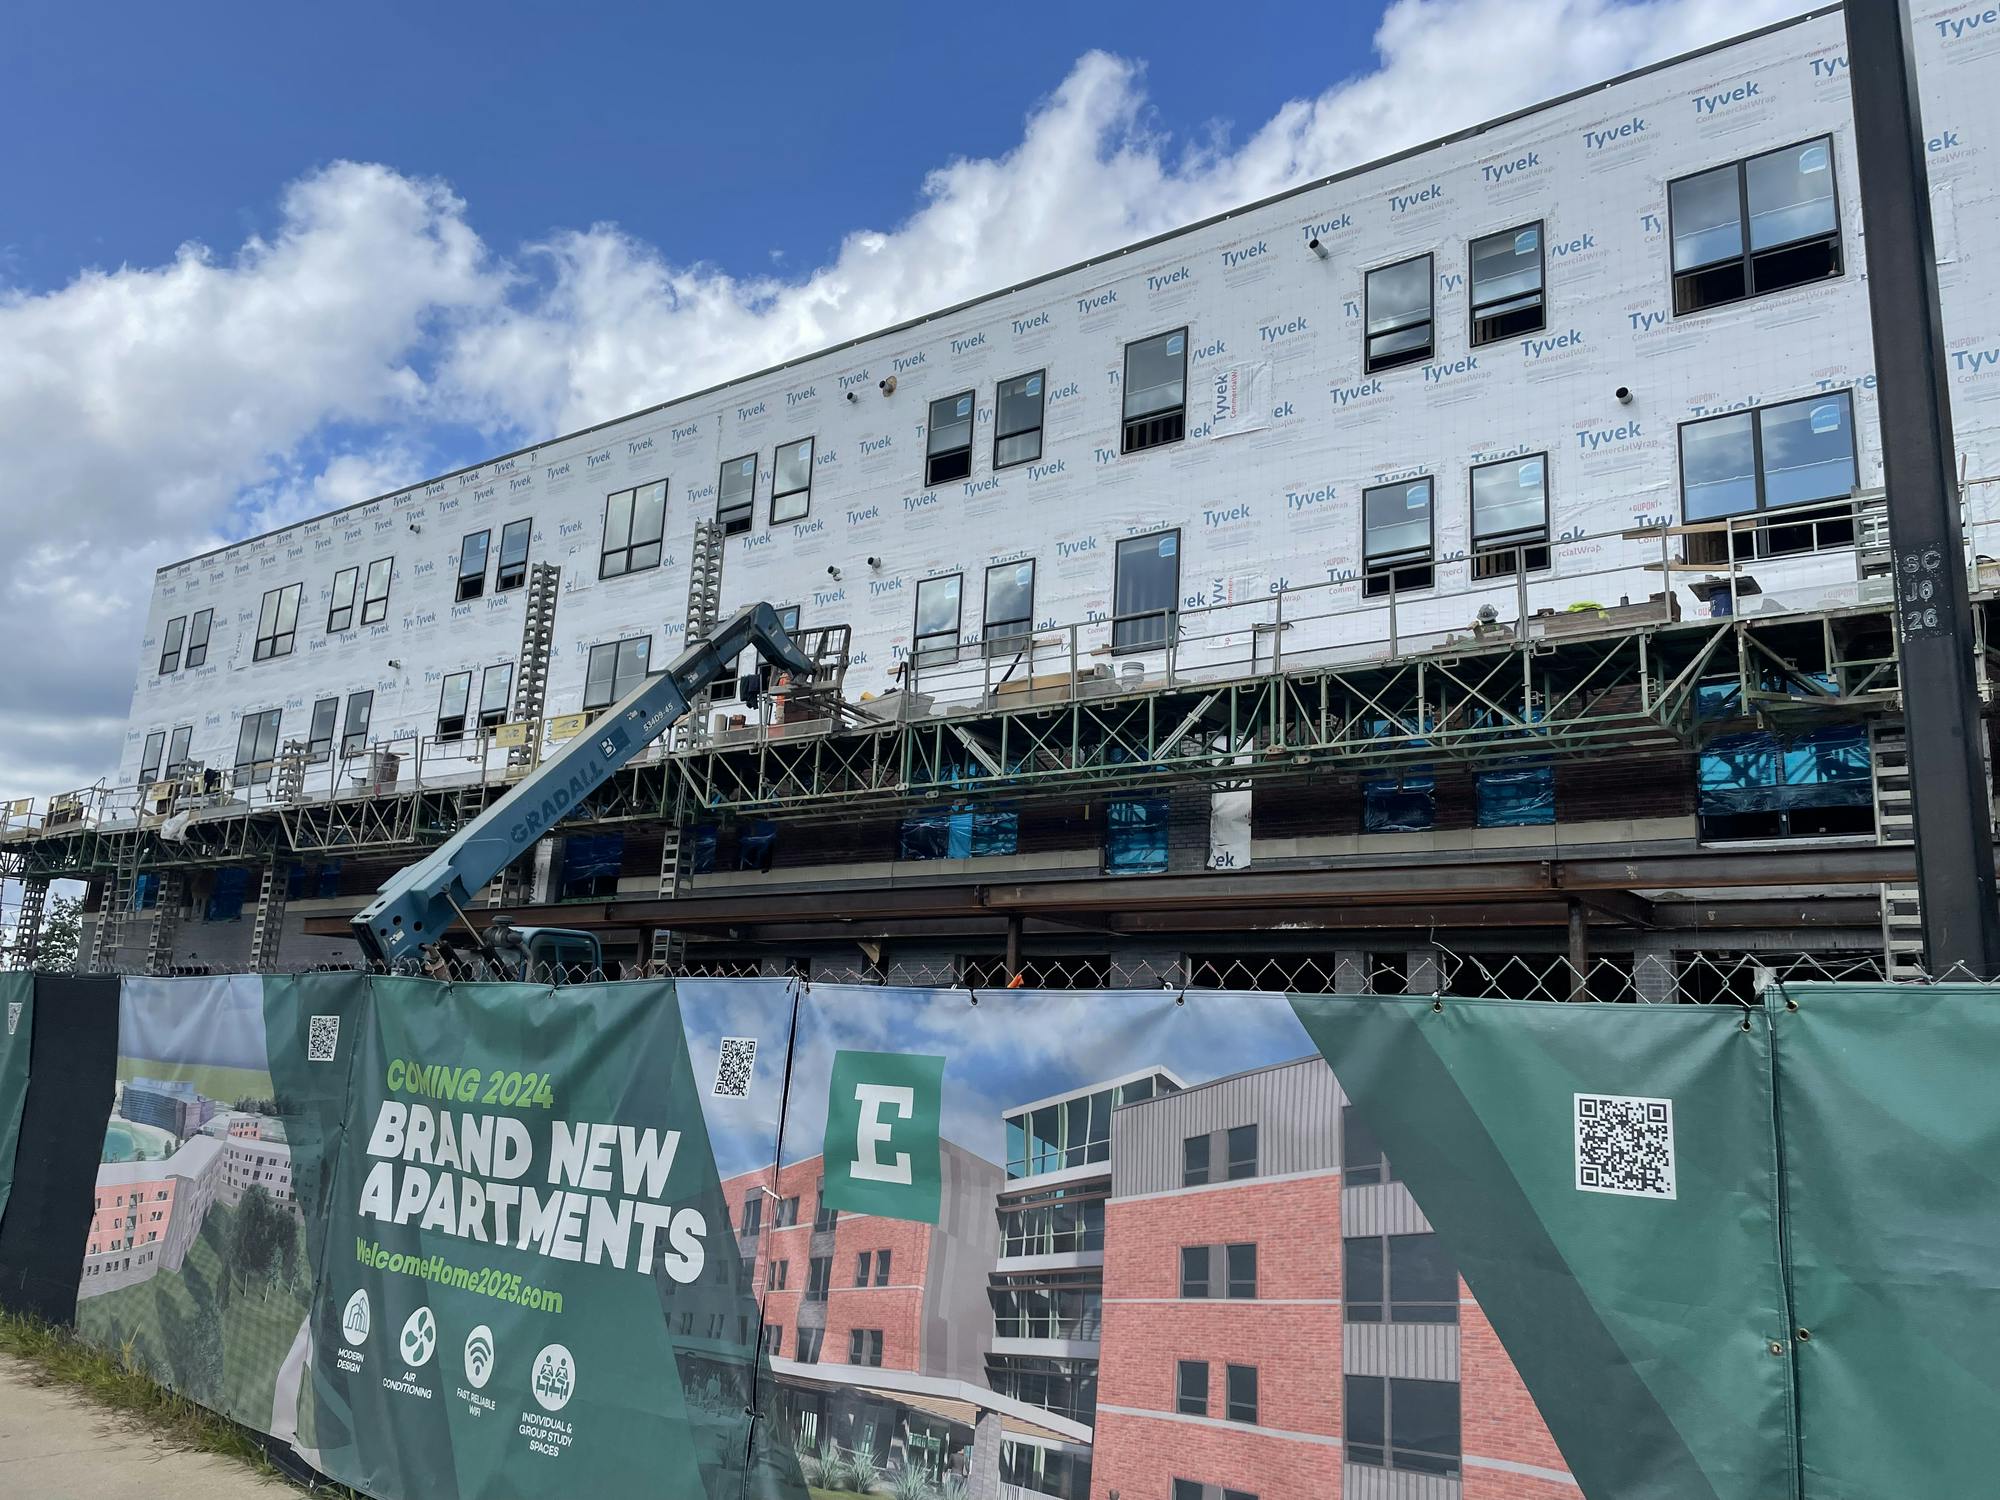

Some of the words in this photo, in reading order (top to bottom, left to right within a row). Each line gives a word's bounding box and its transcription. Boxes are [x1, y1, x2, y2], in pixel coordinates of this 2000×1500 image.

[1935, 9, 2000, 38] Tyve
[1810, 56, 1850, 77] Tyv
[1692, 81, 1760, 114] Tyvek
[1695, 95, 1777, 124] CommercialWrap
[1583, 117, 1645, 148] Tyvek
[1586, 132, 1661, 159] CommercialWrap
[1926, 145, 1977, 167] rcialWrap
[1482, 152, 1538, 182] Tyvek
[1484, 166, 1553, 192] CommercialWrap
[1388, 184, 1441, 212] Tyvek
[1302, 214, 1351, 239] Tyvek
[1221, 241, 1267, 266] Tyvek
[1550, 234, 1594, 257] vek
[1549, 249, 1611, 272] ommercialWrap
[1147, 266, 1190, 291] Tyvek
[1077, 290, 1117, 313] Tyvek
[1011, 312, 1049, 335] Tyvek
[1628, 309, 1665, 331] Tyv
[1259, 316, 1307, 342] Tyvek
[951, 333, 985, 354] Tyvek
[1520, 329, 1582, 358] Tyvek
[893, 352, 925, 372] Tyvek
[1523, 345, 1597, 367] CommercialWrap
[1952, 349, 2000, 372] Tyv
[1422, 356, 1478, 383] Tyvek
[838, 369, 869, 389] Tyvek
[1423, 370, 1492, 392] CommercialWrap
[786, 387, 816, 405] Tyvek
[1049, 383, 1078, 404] yvek
[1213, 373, 1230, 425] Tyvek
[1330, 379, 1382, 406] Tyvek
[738, 403, 765, 420] Tyvek
[1332, 394, 1394, 414] CommercialWrap
[672, 424, 697, 440] Tyvek
[1577, 421, 1641, 450] Tyvek
[628, 438, 653, 454] Tyvek
[860, 435, 892, 454] Tyvek
[1580, 439, 1658, 460] CommercialWrap
[587, 451, 610, 467] Tyvek
[817, 451, 836, 465] vek
[1094, 448, 1116, 464] Tyv
[494, 460, 515, 474] Tyvek
[547, 463, 570, 479] Tyvek
[1027, 460, 1064, 480] Tyvek
[459, 472, 479, 485] Tyvek
[509, 475, 531, 491] Tyvek
[964, 476, 998, 496] Tyvek
[425, 483, 445, 496] Tyvek
[473, 487, 495, 501] Tyvek
[687, 486, 714, 501] Tyvek
[1286, 486, 1336, 510] Tyvek
[393, 493, 411, 507] Tyvek
[439, 499, 459, 512] Tyvek
[903, 492, 937, 511] Tyvek
[362, 504, 380, 517] Tyvek
[406, 508, 426, 522] Tyvek
[847, 506, 879, 524] Tyvek
[1204, 504, 1250, 528] Tyvek
[333, 513, 349, 526] Tyvek
[374, 518, 392, 531] Tyvek
[793, 519, 823, 537] Tyvek
[1634, 514, 1673, 528] Tyv
[304, 524, 320, 535] Tyvek
[344, 528, 362, 541] Tyvek
[559, 521, 583, 536] Tyvek
[251, 541, 266, 552] Tyvek
[277, 533, 293, 544] Tyvek
[315, 537, 331, 549] Tyvek
[742, 533, 771, 549] Tyvek
[1056, 536, 1096, 558] Tyvek
[224, 549, 240, 561] Tyvek
[287, 547, 302, 560] Tyvek
[1558, 543, 1603, 558] rcialWrap
[200, 557, 215, 570] Tyvek
[260, 556, 276, 568] Tyvek
[414, 561, 434, 576] Tyvek
[448, 555, 459, 565] Tyv
[177, 564, 191, 577] Tyvek
[210, 571, 224, 583] Tyvek
[234, 563, 249, 575] Tyvek
[1327, 568, 1357, 583] Tyv
[162, 585, 176, 596] Tyvek
[185, 578, 200, 590] Tyvek
[869, 577, 902, 594] Tyvek
[321, 590, 331, 600] Tyv
[487, 596, 508, 610] Tyvek
[814, 588, 846, 607] Tyvek
[238, 611, 253, 623] Tyvek
[416, 611, 436, 626] Tyvek
[451, 604, 471, 618] Tyvek
[1907, 608, 1938, 630] 26
[371, 624, 389, 637] Tyvek
[403, 617, 413, 630] Tyv
[664, 622, 685, 636] Tyve
[310, 639, 327, 650] Tyvek
[340, 631, 357, 644] Tyvek
[892, 645, 910, 658] Tyv
[378, 680, 397, 691] Tyvek
[510, 760, 603, 843] GRADALL
[387, 1059, 480, 1103] COMING
[482, 1071, 554, 1109] 2024
[850, 1083, 914, 1185] E
[366, 1100, 533, 1180] BRAND
[547, 1121, 681, 1198] NEW
[359, 1162, 707, 1284] APARTMENTS
[356, 1236, 563, 1313] WelcomeHome2025.com
[338, 1348, 365, 1362] MODERN
[337, 1359, 360, 1373] DESIGN
[402, 1372, 416, 1382] AIR
[383, 1378, 432, 1399] CONDITIONING
[471, 1393, 496, 1411] RELIABLE
[522, 1412, 566, 1432] INDIVIDUAL
[567, 1423, 573, 1434] &
[519, 1424, 547, 1440] GROUP
[547, 1431, 573, 1447] STUDY
[530, 1440, 559, 1457] SPACES
